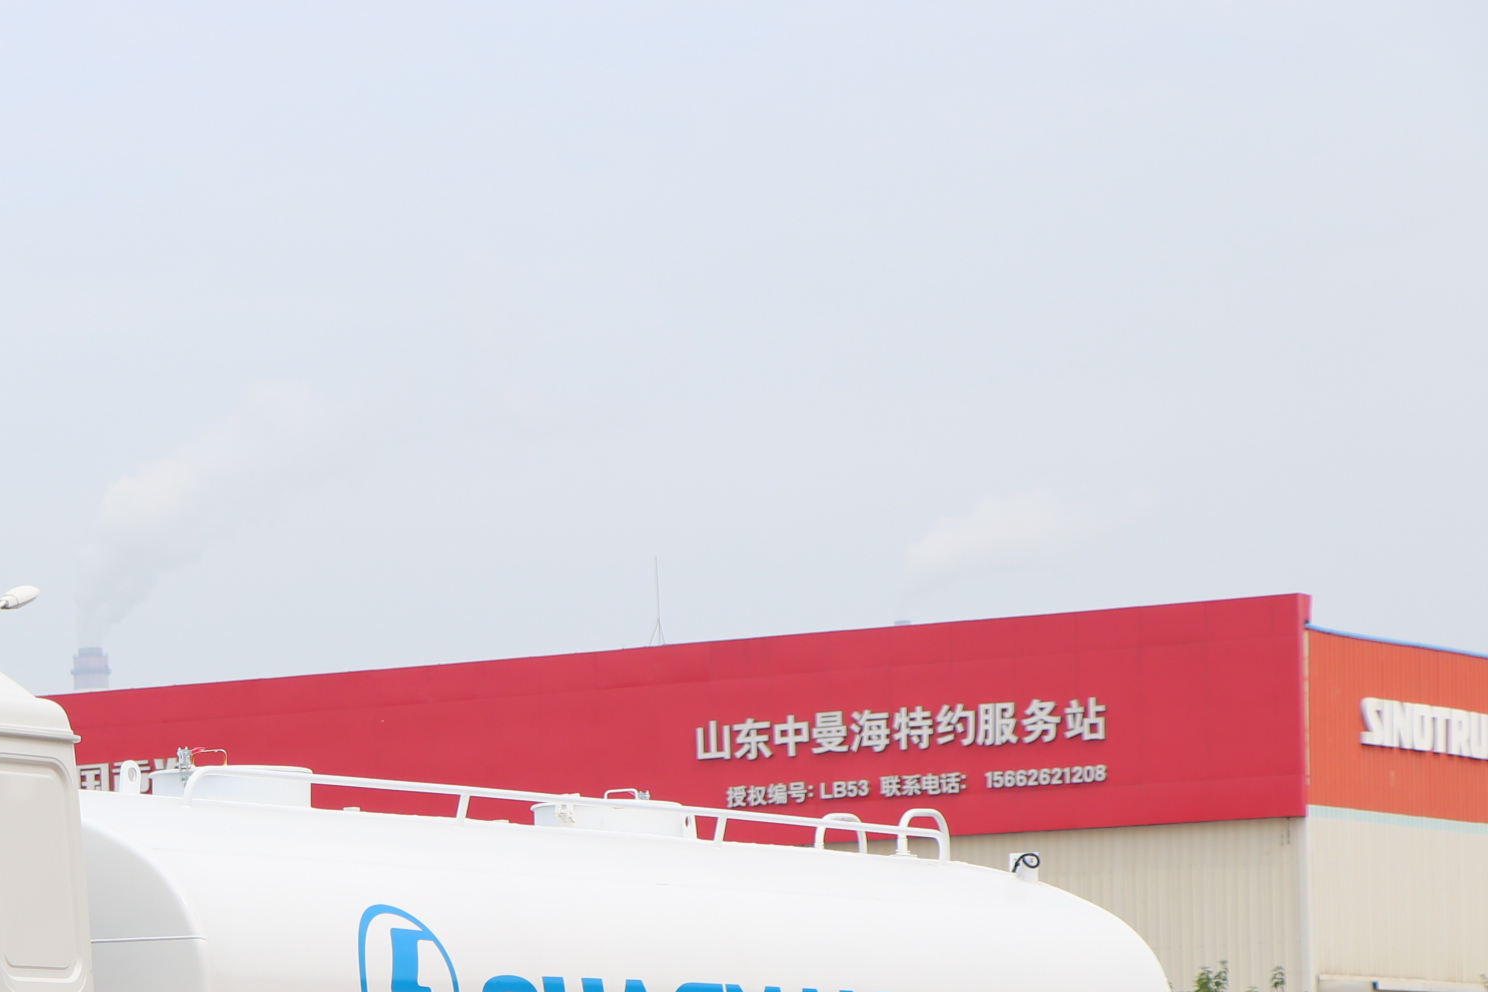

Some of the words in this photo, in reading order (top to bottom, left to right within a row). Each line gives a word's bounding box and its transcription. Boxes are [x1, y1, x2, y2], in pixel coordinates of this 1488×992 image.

[695, 697, 1107, 761] 山东中曼海特约服务站
[819, 780, 870, 799] LB53
[984, 764, 1108, 789] 15662621208
